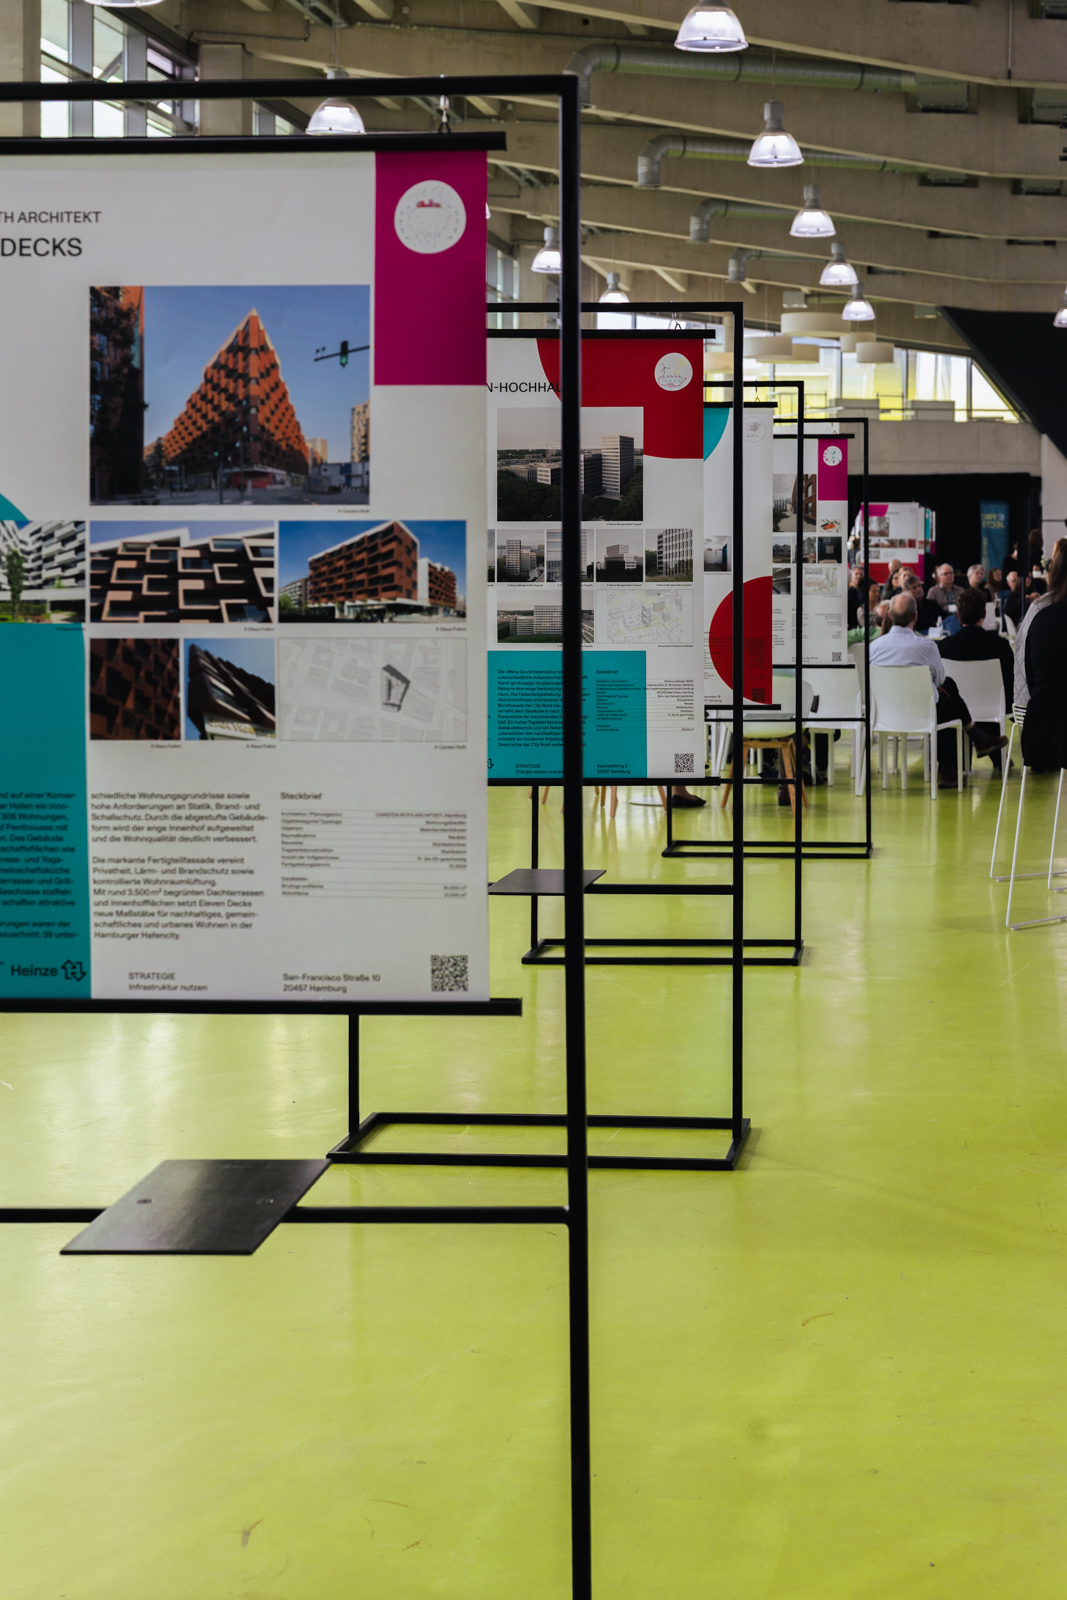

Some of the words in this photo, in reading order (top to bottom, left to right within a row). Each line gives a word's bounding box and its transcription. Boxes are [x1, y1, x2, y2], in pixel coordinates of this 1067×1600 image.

[18, 211, 101, 223] ARCHITEKT
[1, 238, 82, 256] DECKS
[138, 793, 225, 801] Wohnungsgrundrisse
[113, 803, 174, 812] Anforderungen
[17, 813, 68, 822] Wohnungen,
[184, 814, 227, 822] abgestufte
[207, 825, 254, 833] aufgeweitet
[41, 856, 63, 865] Yoga-
[148, 856, 215, 865] Fertigteilfassade
[170, 911, 223, 919] nachhaltiges,
[11, 964, 58, 976] Heinze
[310, 985, 347, 994] Hamburg
